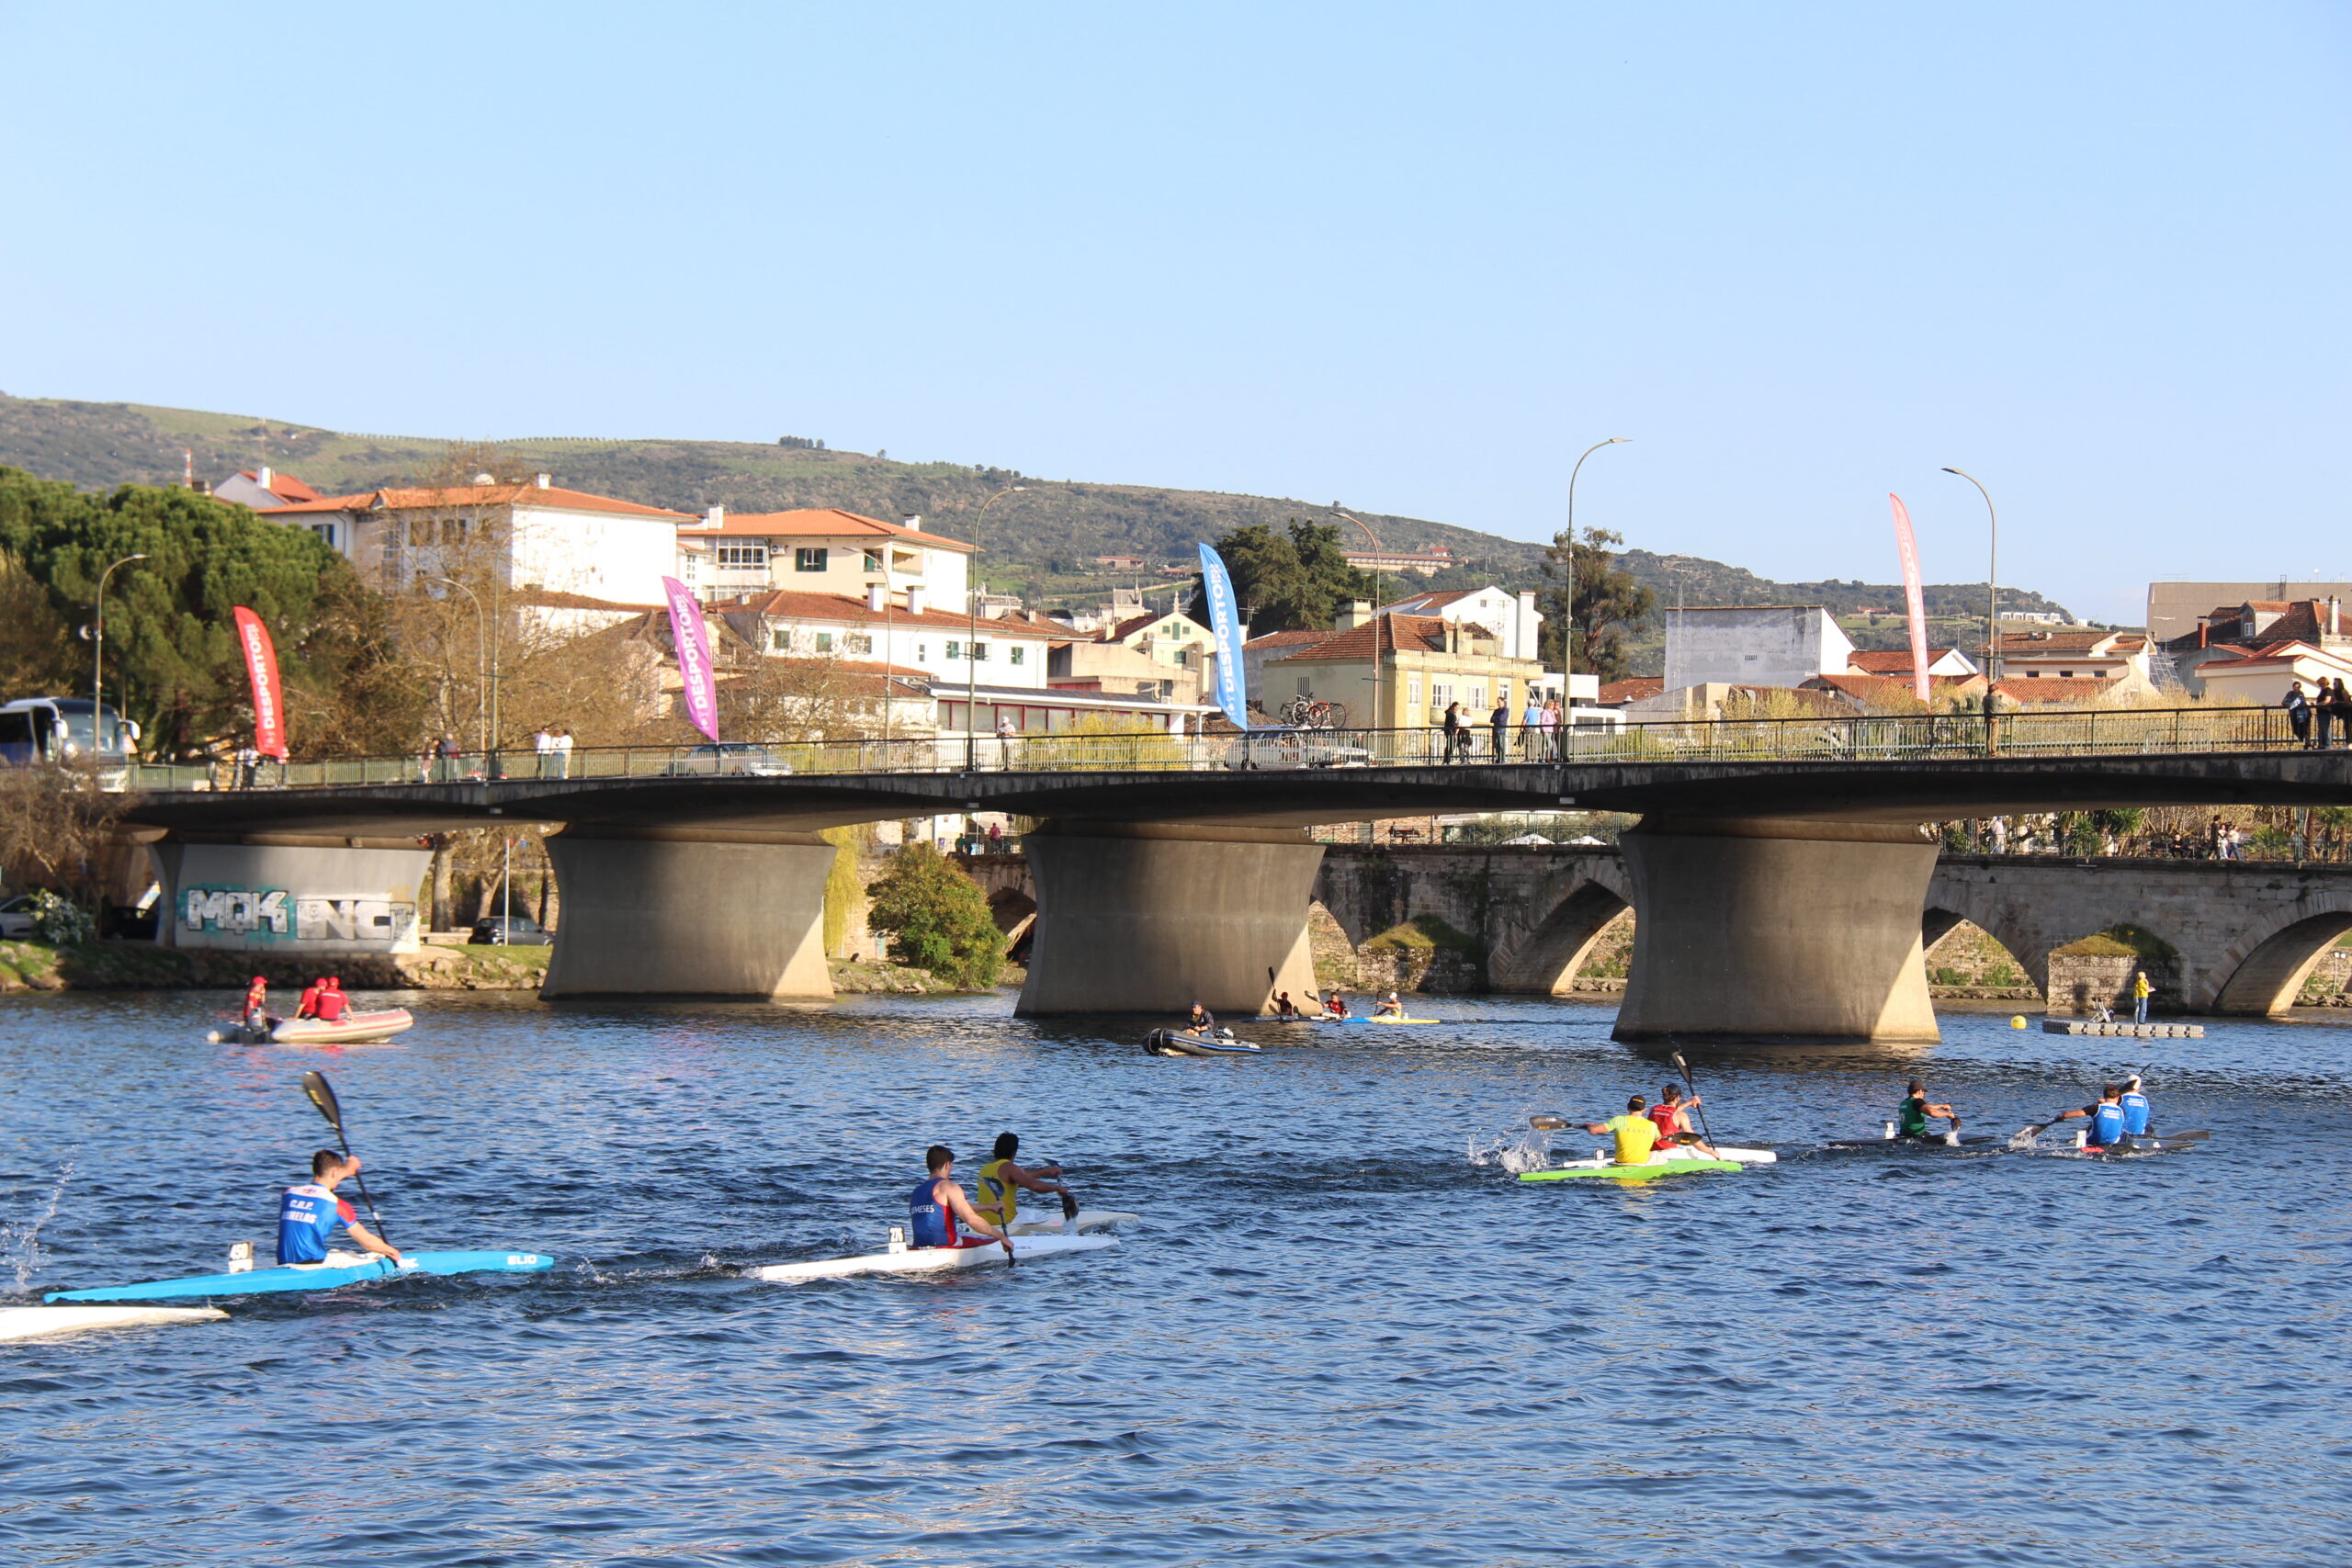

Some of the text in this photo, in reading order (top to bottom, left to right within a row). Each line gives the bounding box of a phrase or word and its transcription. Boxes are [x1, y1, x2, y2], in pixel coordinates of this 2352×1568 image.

[679, 613, 707, 708] DESPORTO
[1213, 583, 1235, 693] DESPORTO
[250, 642, 276, 729] DESPORTO
[507, 1255, 538, 1266] ELIO
